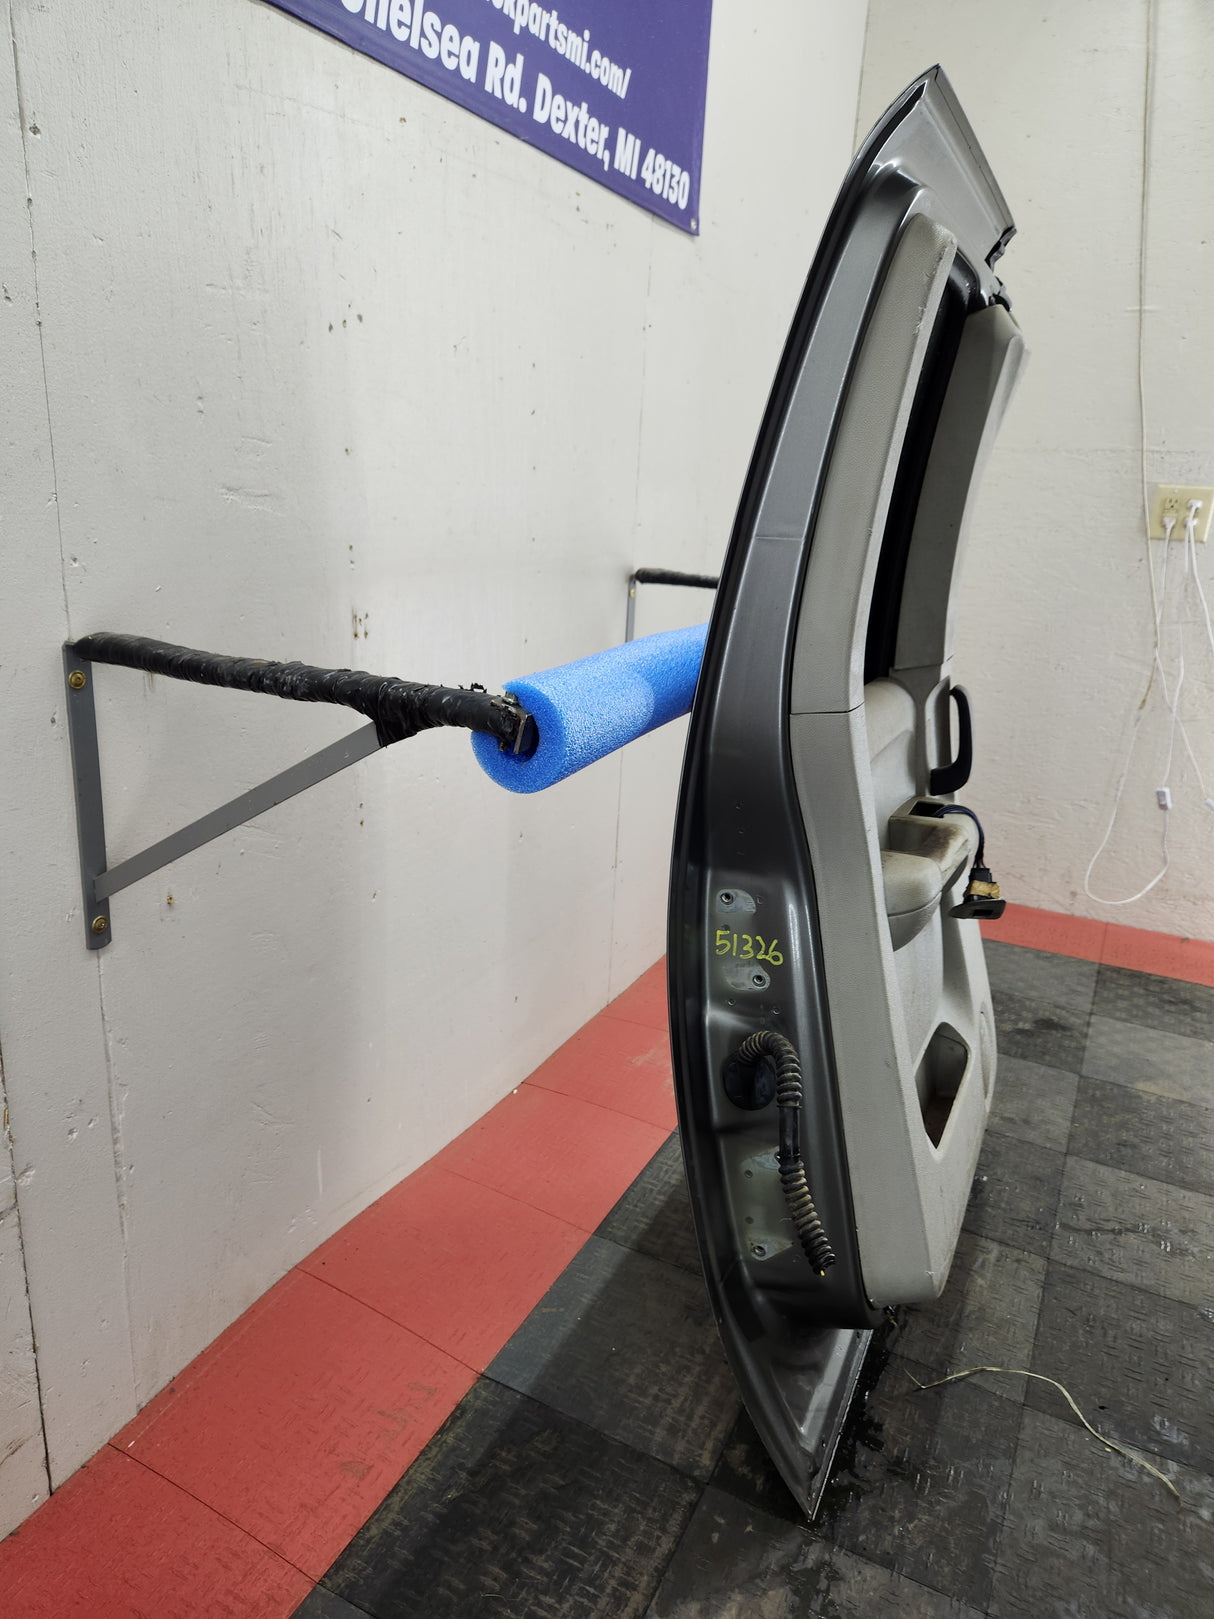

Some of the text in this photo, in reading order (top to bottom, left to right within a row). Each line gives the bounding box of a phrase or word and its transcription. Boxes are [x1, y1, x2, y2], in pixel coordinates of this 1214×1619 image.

[491, 0, 632, 99] partsmi.com/
[341, 0, 690, 210] elsea Rd. Dexter, MI 48130
[715, 929, 784, 966] 51326
